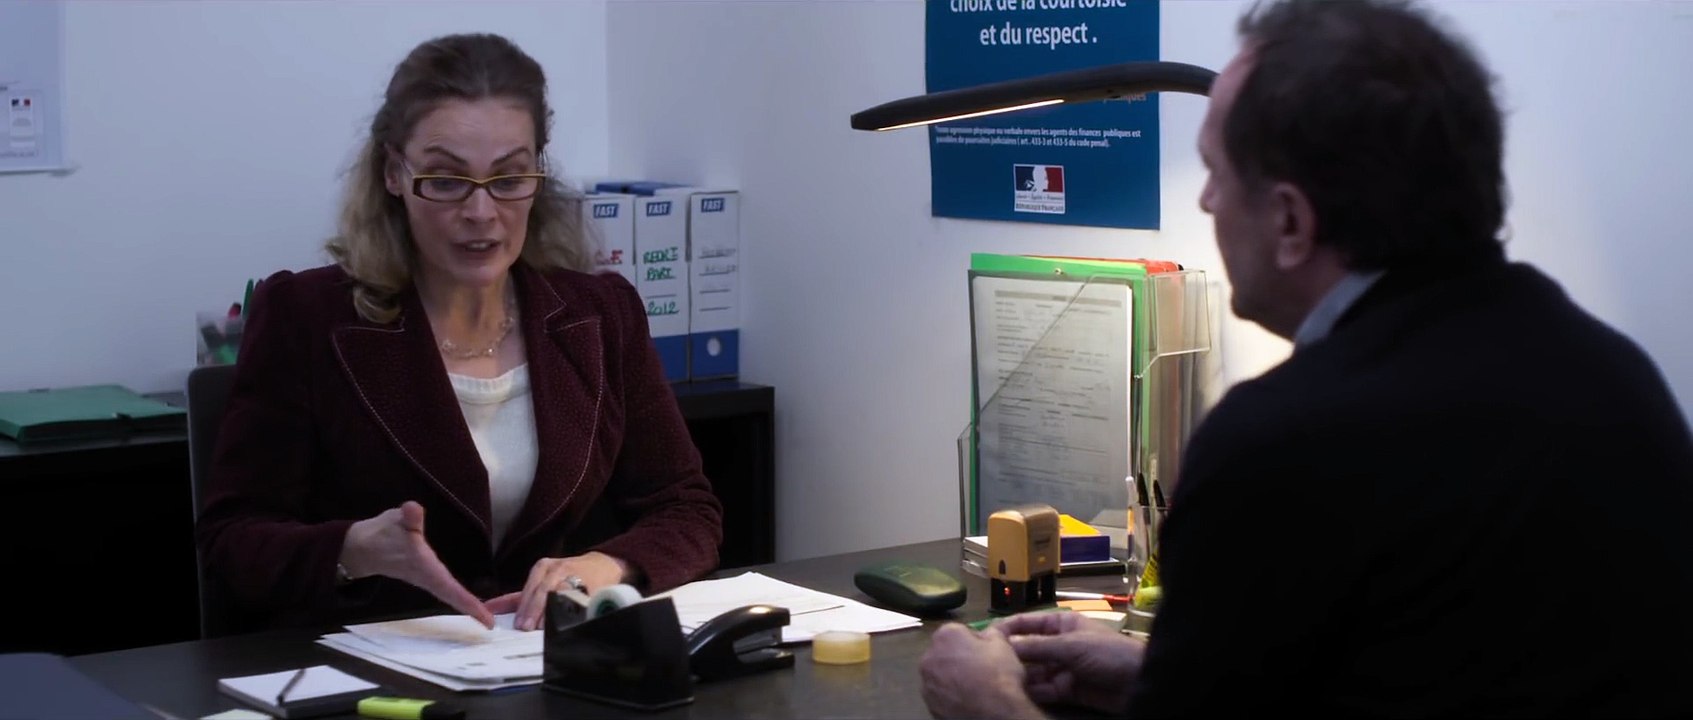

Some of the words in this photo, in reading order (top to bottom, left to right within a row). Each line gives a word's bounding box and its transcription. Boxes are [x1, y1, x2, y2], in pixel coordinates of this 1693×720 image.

[980, 24, 997, 45] et
[1000, 21, 1022, 45] du
[1026, 22, 1089, 50] respect
[1068, 128, 1078, 136] des
[1079, 128, 1102, 137] finances
[1103, 128, 1131, 139] publiques
[1132, 130, 1141, 138] est
[596, 205, 615, 216] FAST
[648, 203, 668, 214] FAST
[702, 200, 721, 210] FAST
[647, 301, 679, 316] 2012
